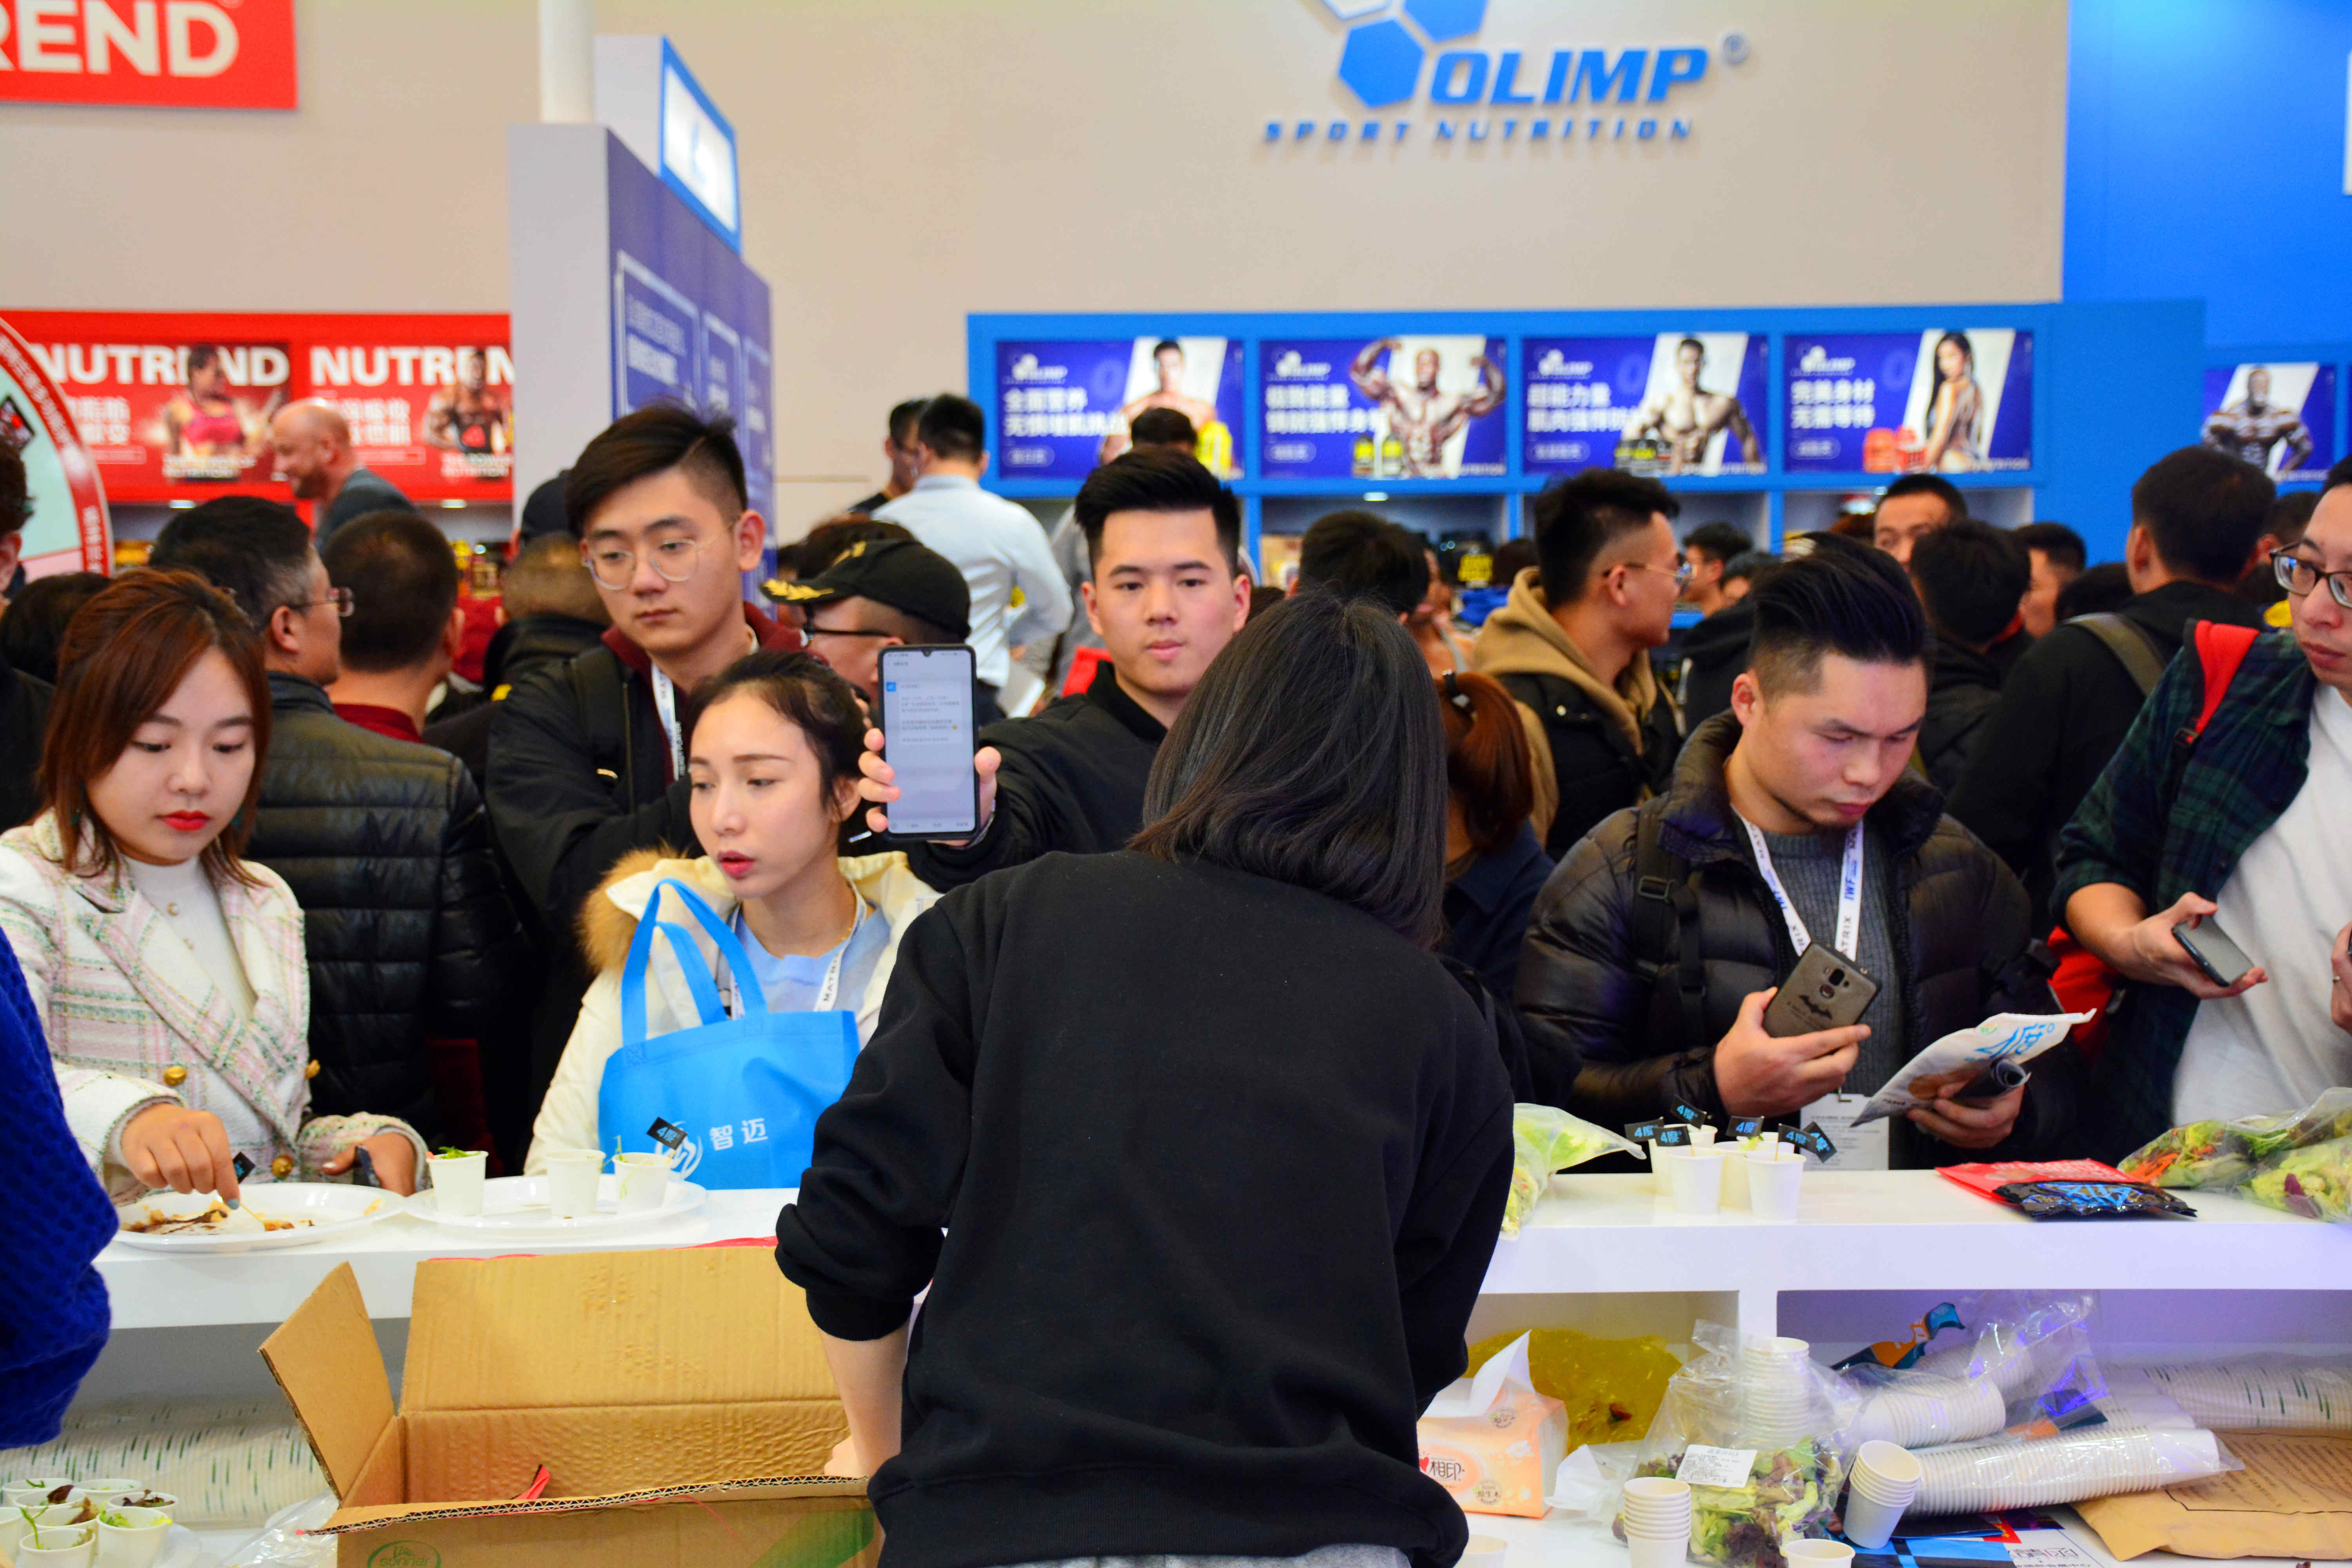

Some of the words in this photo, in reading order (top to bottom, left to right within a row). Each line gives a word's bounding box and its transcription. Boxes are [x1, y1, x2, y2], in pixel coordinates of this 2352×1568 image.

[0, 0, 239, 77] END
[1429, 48, 1709, 105] OLIMP
[1263, 122, 1410, 142] SPORT
[1436, 117, 1693, 140] NUTRITION
[28, 343, 290, 386] NUTRND
[710, 1118, 768, 1151] 智迈
